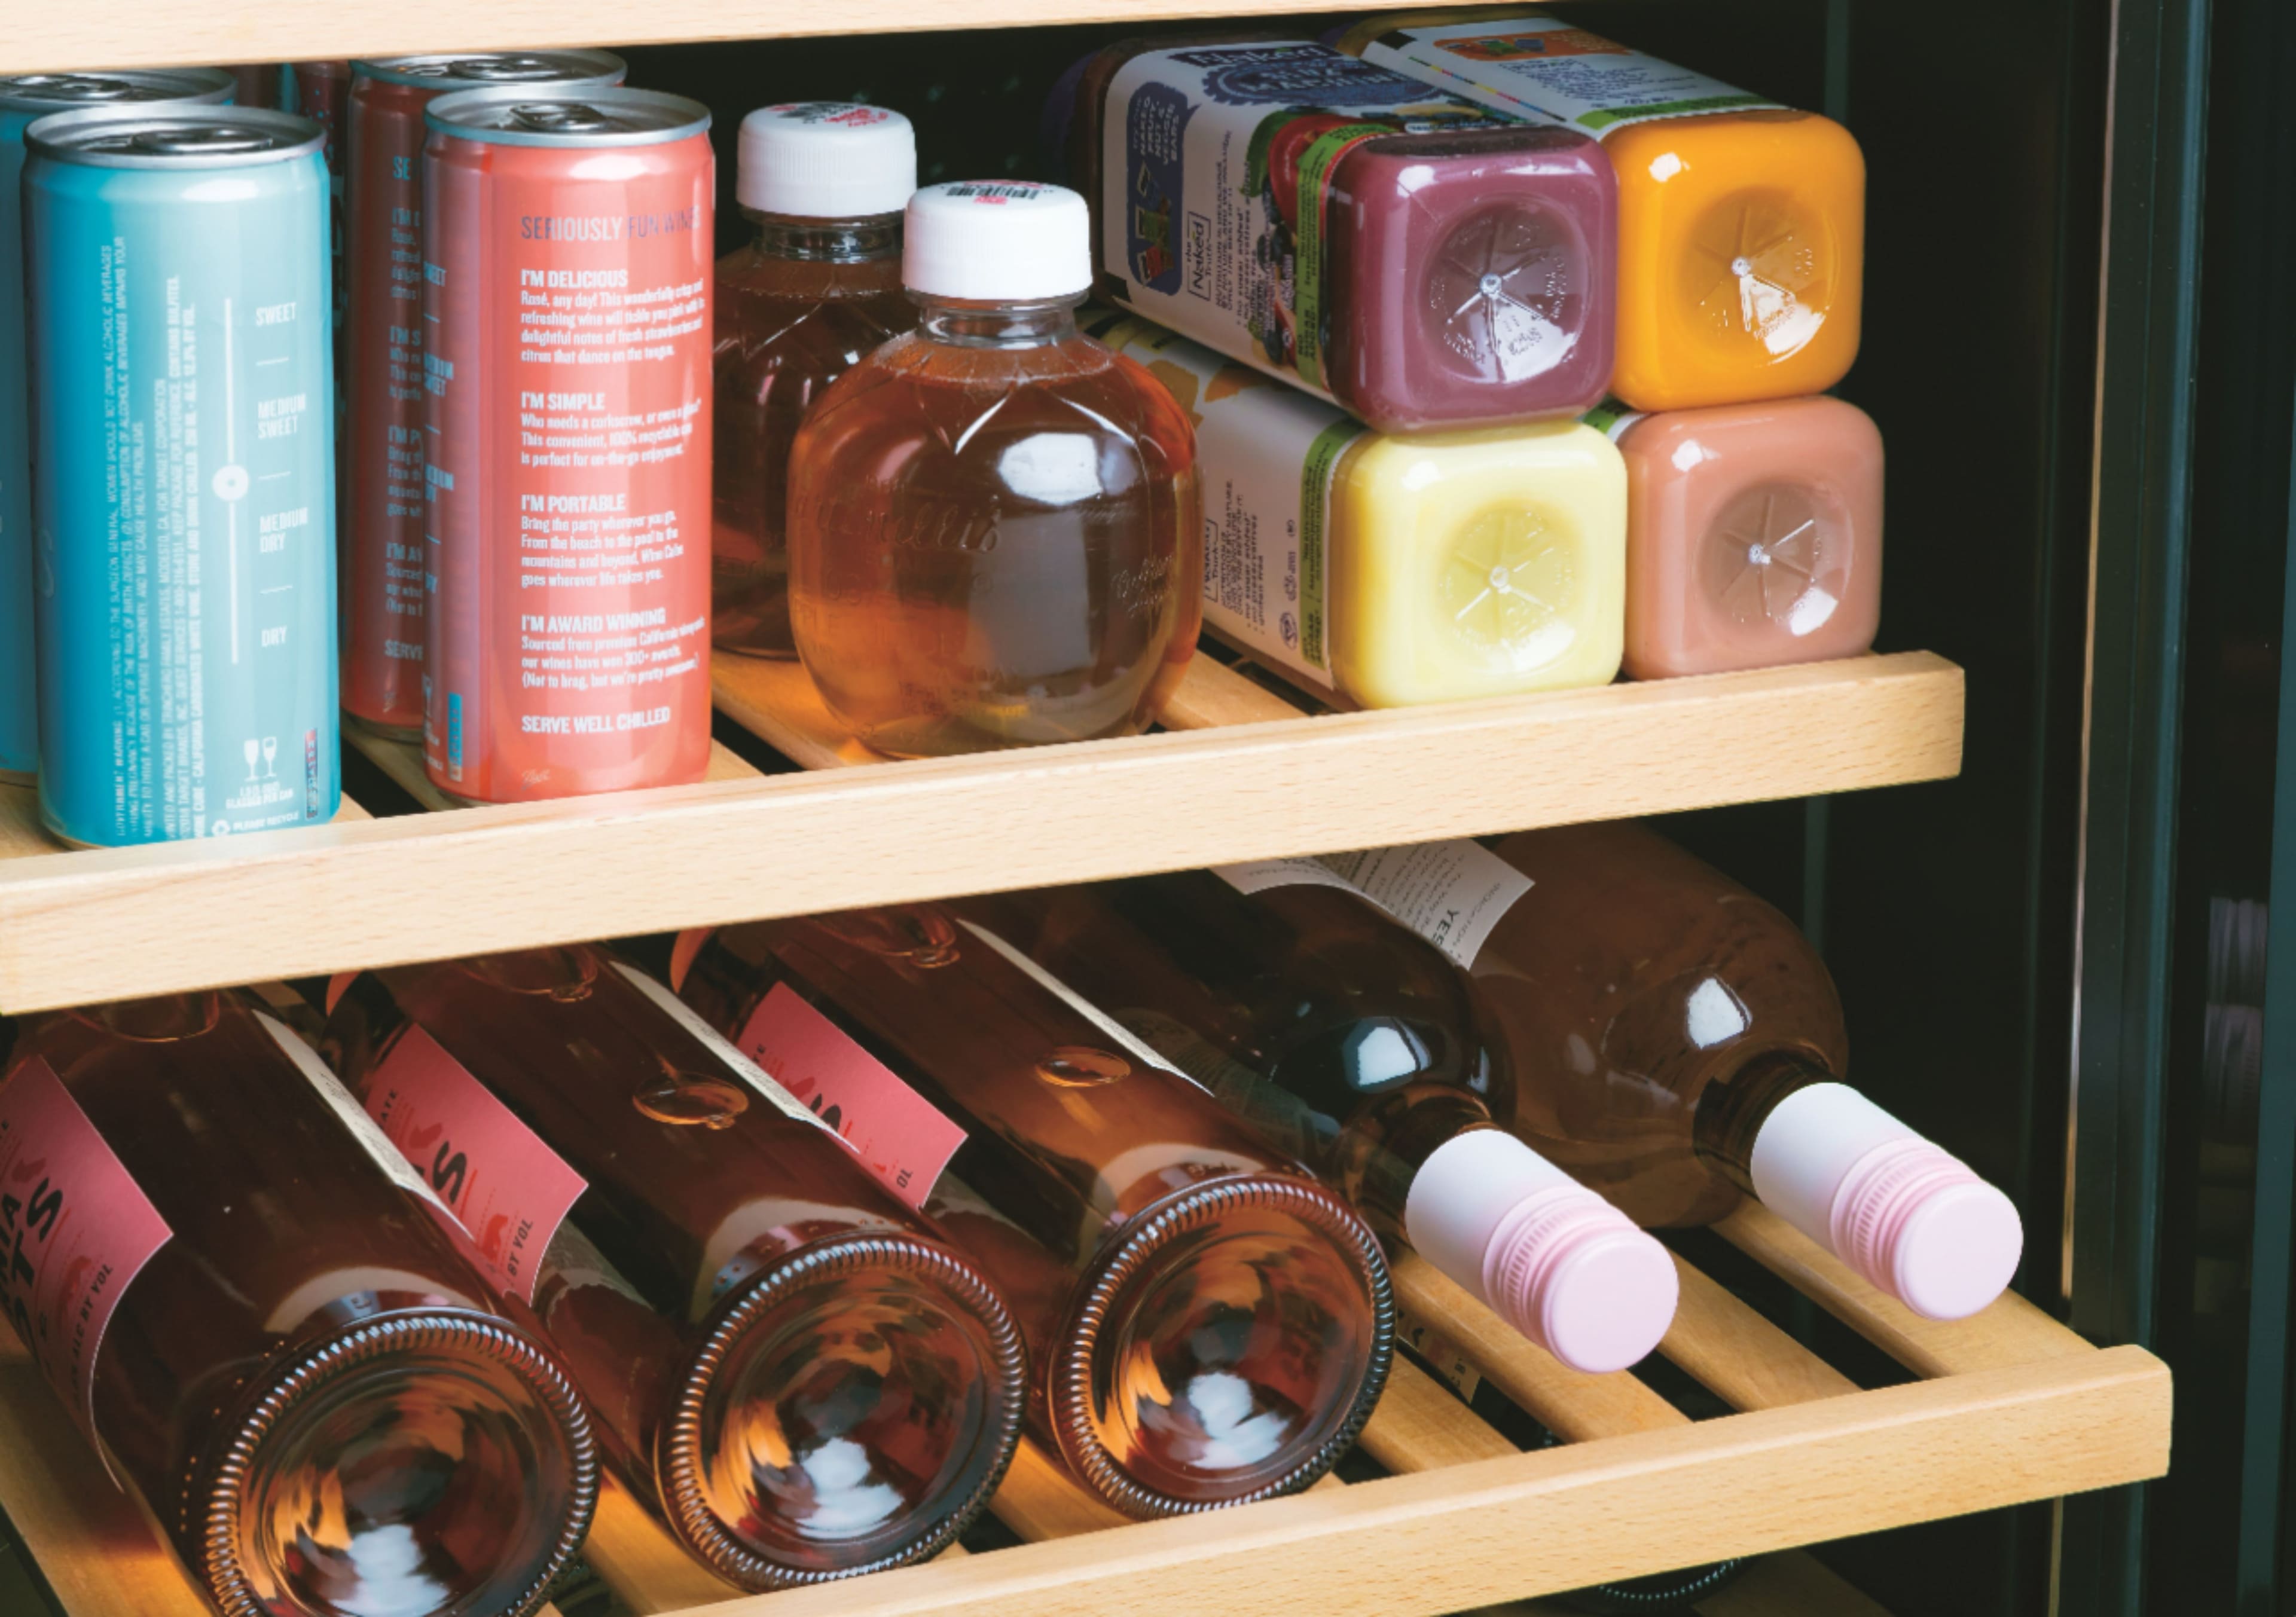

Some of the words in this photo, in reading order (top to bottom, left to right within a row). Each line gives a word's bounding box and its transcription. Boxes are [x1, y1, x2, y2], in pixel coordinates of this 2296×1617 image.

[521, 216, 622, 242] SERIOUSLY
[628, 213, 658, 239] FUN
[113, 236, 126, 265] YOUR
[1191, 221, 1204, 290] Naked
[100, 245, 114, 304] BEVERAGES
[521, 268, 544, 288] I'M
[548, 270, 628, 288] DELICIOUS
[521, 290, 549, 308] Rosé,
[552, 294, 572, 310] any
[600, 292, 622, 306] This
[255, 301, 297, 327] SWEET
[521, 311, 576, 329] refreshing
[578, 312, 603, 326] wine
[605, 310, 623, 325] will
[521, 330, 571, 347] delightful
[573, 332, 603, 345] notes
[606, 331, 616, 344] of
[521, 349, 551, 363] citrus
[554, 349, 576, 363] that
[578, 349, 610, 363] dance
[612, 351, 624, 363] on
[627, 347, 643, 362] the
[257, 392, 307, 420] MEDIUM
[521, 391, 544, 410] I'M
[547, 392, 606, 411] SIMPLE
[257, 414, 298, 440] SWEET
[521, 412, 544, 429] Who
[547, 414, 579, 429] needs
[581, 417, 588, 429] a
[521, 431, 542, 447] This
[546, 432, 607, 448] convenient,
[532, 451, 570, 467] perfect
[573, 451, 588, 467] for
[521, 494, 544, 512] I'M
[547, 493, 627, 513] PORTABLE
[259, 507, 309, 534] MEDIUM
[521, 515, 549, 534] Bring
[552, 517, 569, 531] the
[572, 516, 599, 534] party
[602, 514, 646, 531] wherever
[259, 533, 287, 555] DRY
[521, 533, 548, 550] From
[550, 535, 567, 550] the
[570, 535, 602, 550] beach
[604, 536, 615, 549] to
[617, 533, 632, 548] the
[521, 554, 576, 568] mountains
[579, 554, 599, 568] and
[521, 574, 546, 589] goes
[548, 571, 597, 588] wherever
[600, 570, 616, 586] life
[521, 613, 544, 633] I'M
[547, 613, 604, 634] AWARD
[606, 606, 667, 632] WINNING
[261, 625, 288, 649] DRY
[521, 635, 566, 652] Sourced
[567, 635, 593, 652] from
[594, 635, 638, 653] premium
[521, 656, 539, 669] our
[541, 655, 572, 670] wines
[574, 655, 599, 670] have
[602, 655, 624, 668] won
[548, 673, 559, 688] to
[561, 673, 589, 692] brag,
[591, 672, 609, 687] but
[521, 714, 571, 735] SERVE
[573, 714, 613, 734] WELL
[616, 706, 671, 730] CHILLED
[512, 1218, 534, 1250] VOL
[507, 1251, 520, 1277] BY
[79, 1295, 94, 1323] BY
[90, 1262, 114, 1294] VOL
